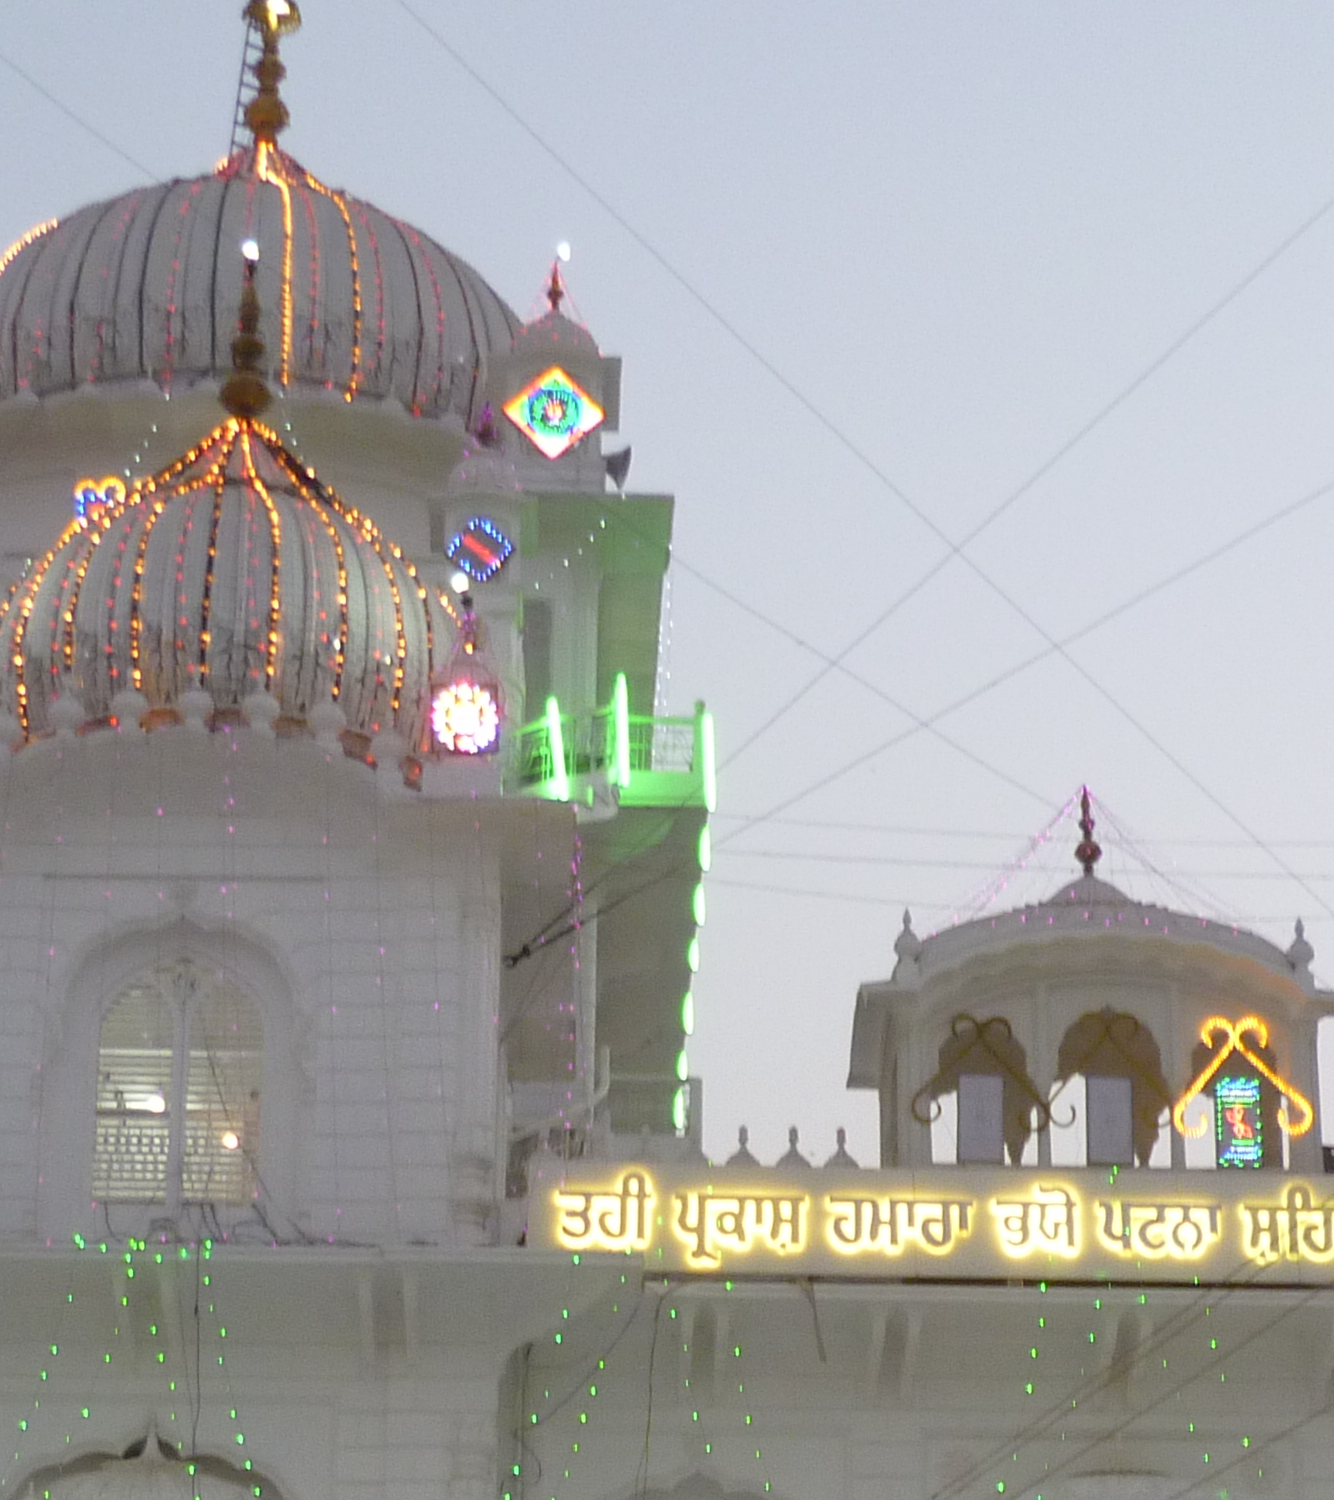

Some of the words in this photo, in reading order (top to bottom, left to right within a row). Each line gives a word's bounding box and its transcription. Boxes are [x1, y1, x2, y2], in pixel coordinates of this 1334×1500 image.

[555, 1170, 655, 1243] ਤਹੀ
[827, 1194, 975, 1249] ਹਮਾਰਾ
[1096, 1199, 1223, 1252] ਪਟਨਾ
